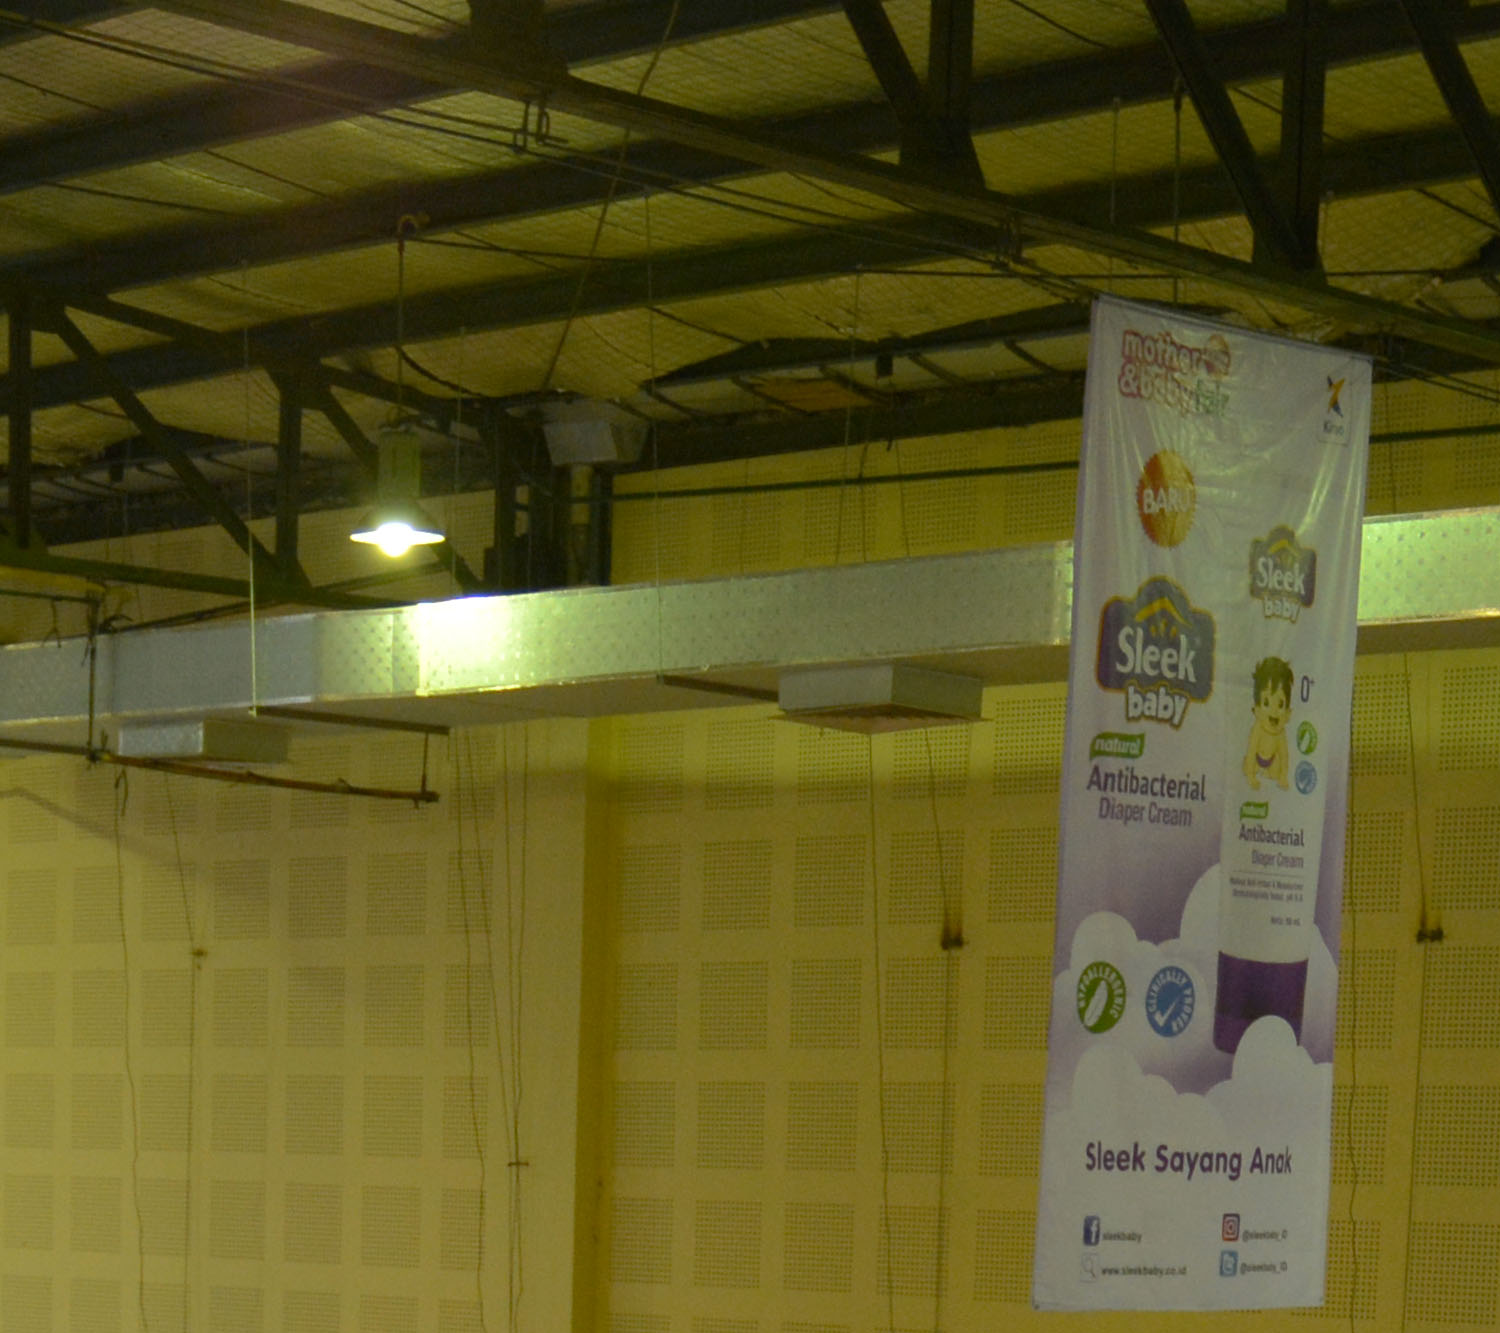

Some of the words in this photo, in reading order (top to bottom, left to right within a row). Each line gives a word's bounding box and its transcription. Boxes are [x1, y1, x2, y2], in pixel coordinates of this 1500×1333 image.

[1142, 486, 1197, 514] BARU
[1255, 555, 1306, 597] Sleek
[1262, 596, 1302, 625] baby
[1115, 630, 1198, 684] Sleek
[1125, 684, 1190, 728] baby
[1086, 764, 1207, 801] Antibacterial
[1099, 797, 1146, 828] Diaper
[1148, 800, 1193, 828] Cream
[1238, 823, 1305, 848] Antibacterial
[1085, 1141, 1146, 1173] Sleek
[1155, 1143, 1242, 1181] Sayang
[1249, 1145, 1293, 1176] Anak
